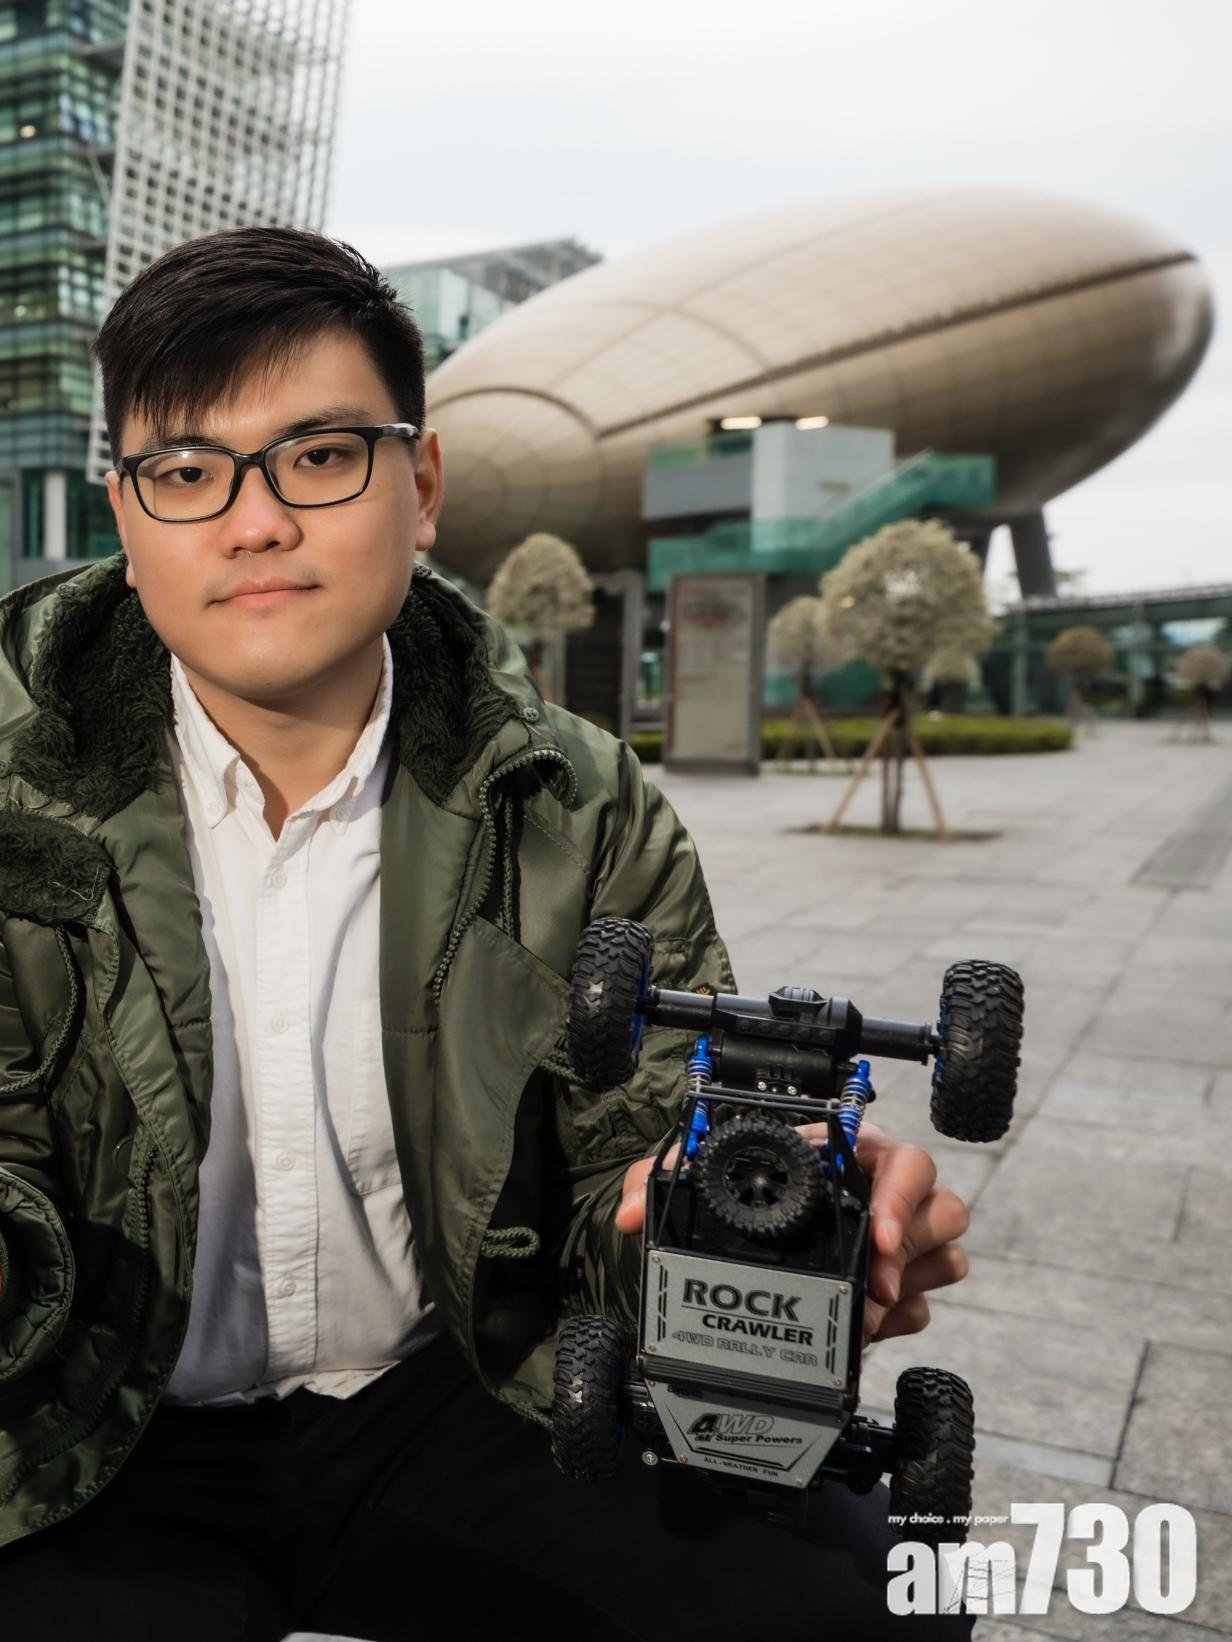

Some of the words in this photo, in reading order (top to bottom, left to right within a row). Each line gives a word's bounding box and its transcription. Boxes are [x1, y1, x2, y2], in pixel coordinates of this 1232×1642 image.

[682, 1277, 802, 1323] ROCK
[702, 1314, 814, 1346] CRAWLER
[671, 1330, 714, 1347] 4WD
[717, 1337, 776, 1359] RALLY
[779, 1348, 818, 1367] CAR
[715, 1434, 752, 1444] Super
[755, 1434, 803, 1444] Powers
